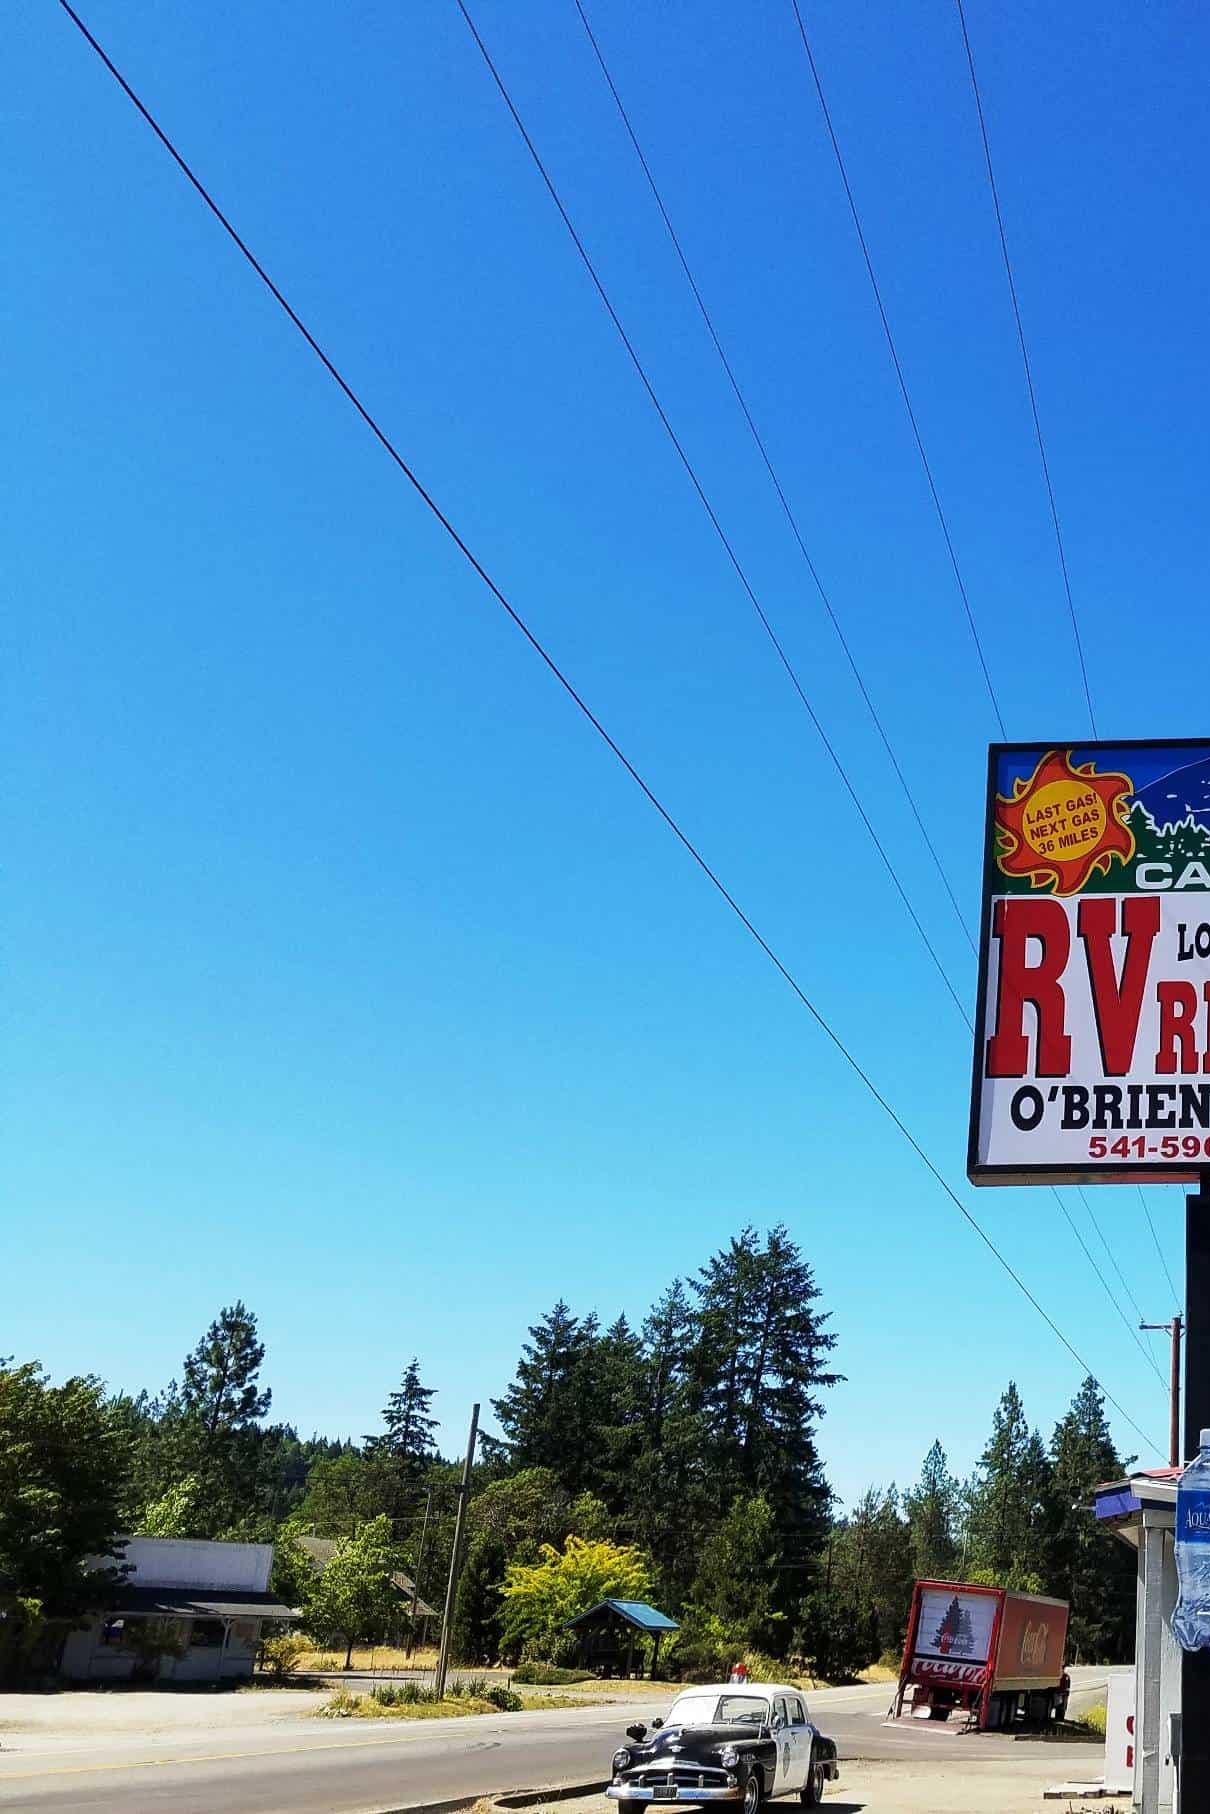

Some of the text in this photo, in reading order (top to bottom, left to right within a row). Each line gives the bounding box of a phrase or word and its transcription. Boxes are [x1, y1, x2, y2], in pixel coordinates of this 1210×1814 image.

[1026, 792, 1098, 825] LAST GAS!
[1029, 808, 1100, 841] NEXT GAS
[1038, 827, 1099, 855] 36 MILES
[985, 896, 1161, 1078] RV
